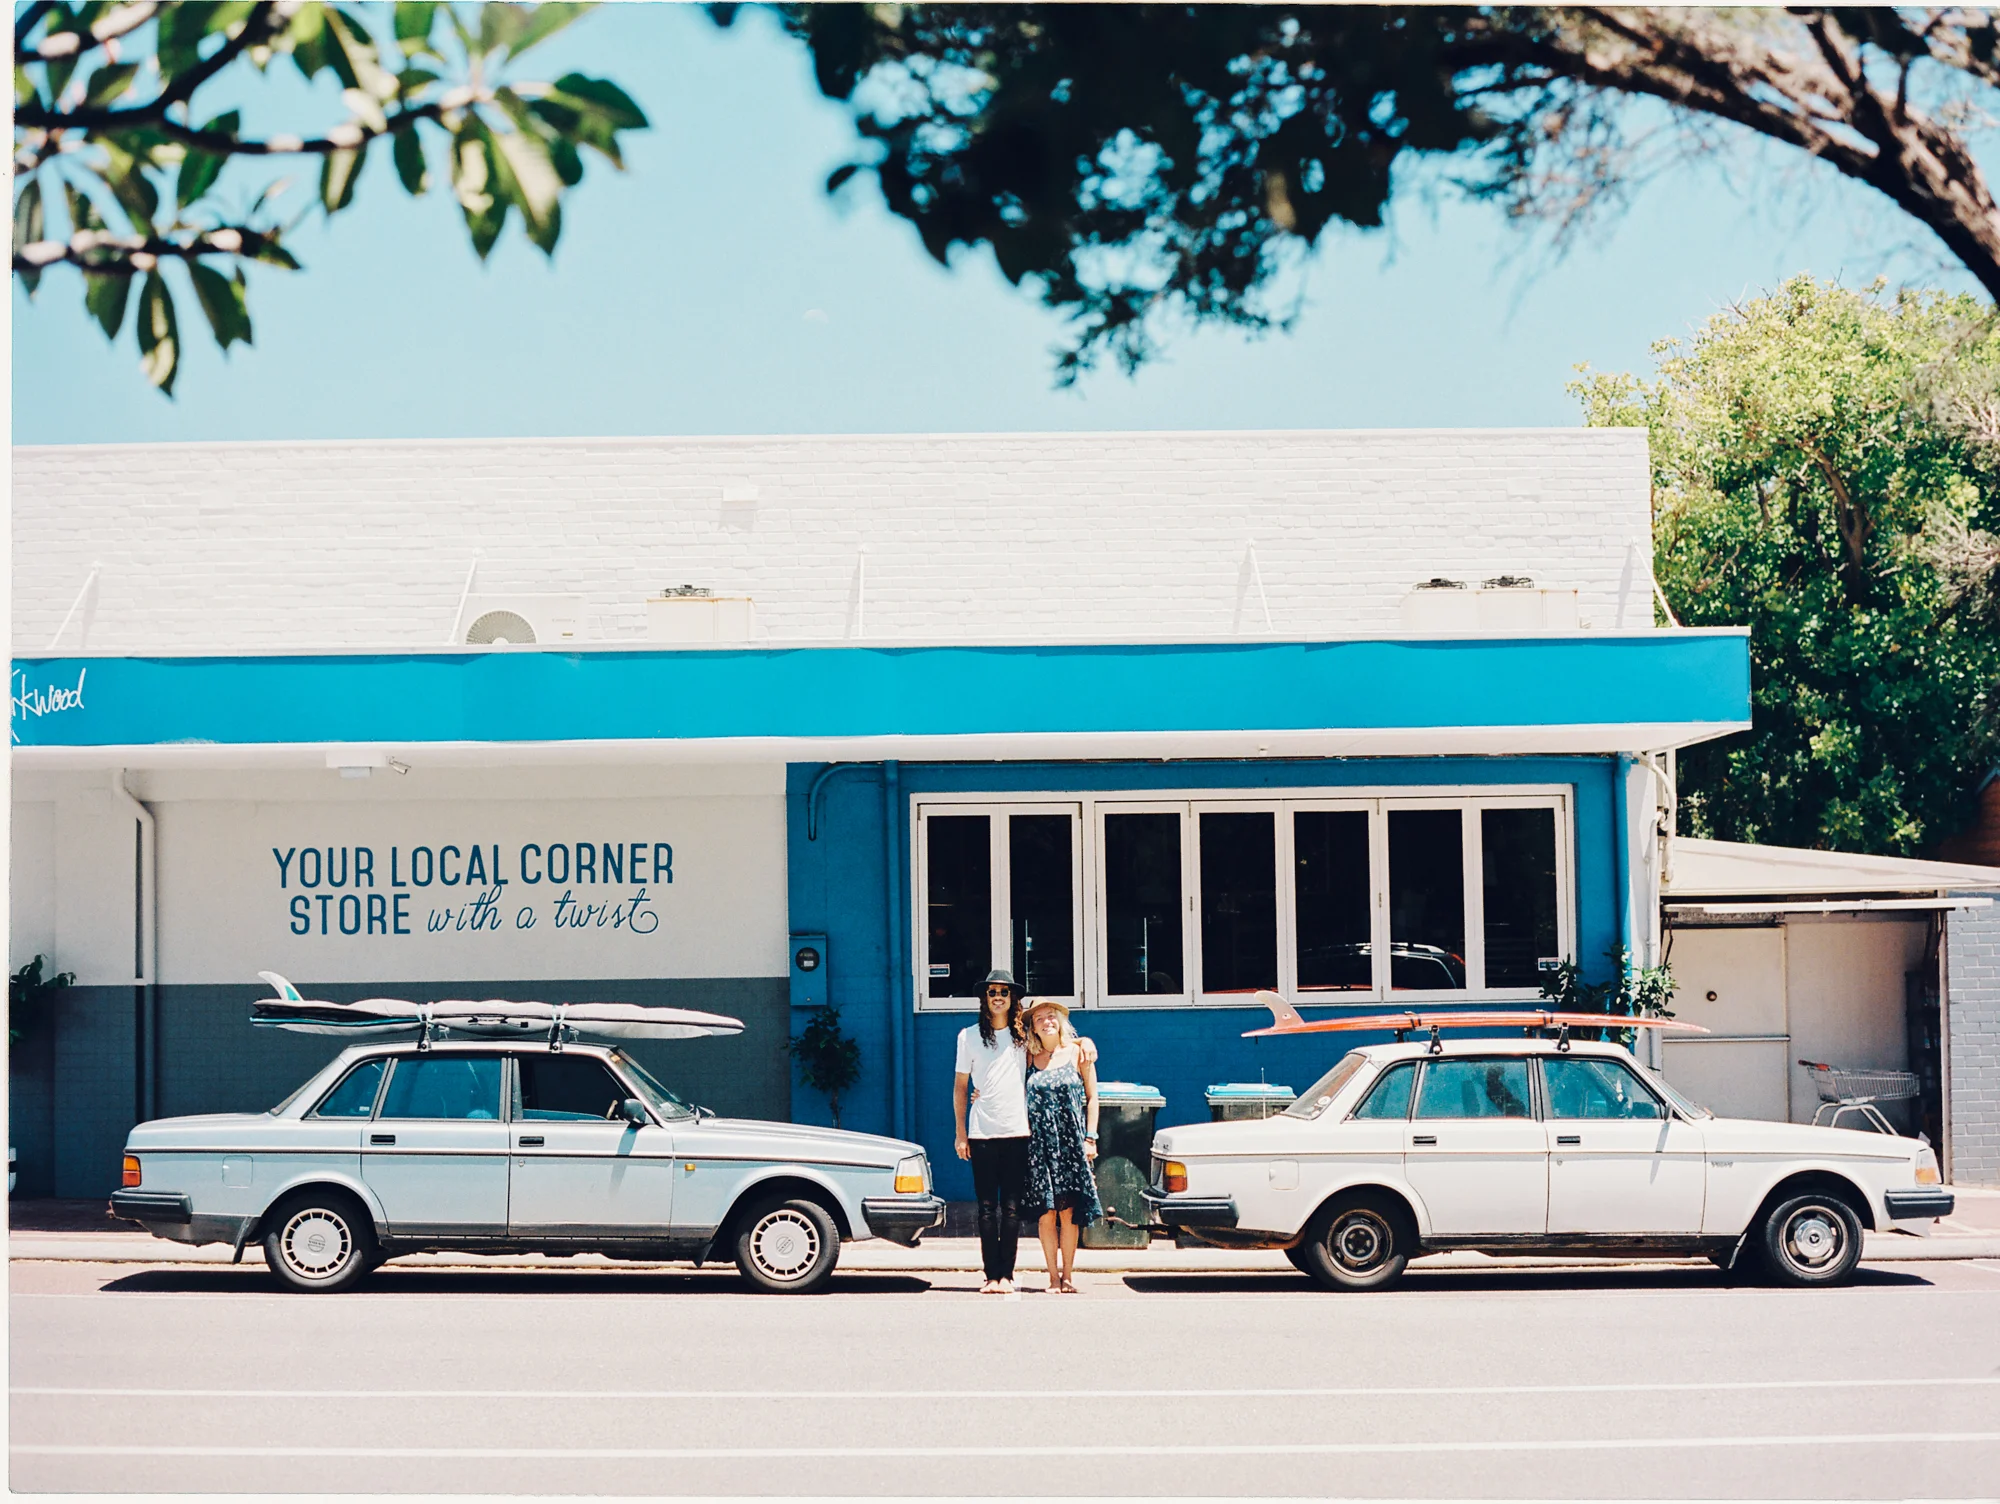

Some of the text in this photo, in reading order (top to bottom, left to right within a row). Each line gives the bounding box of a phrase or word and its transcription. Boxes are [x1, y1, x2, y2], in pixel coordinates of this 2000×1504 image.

[271, 842, 674, 889] YOUR LOCAL CORNER
[289, 884, 659, 936] STORE with a twist
